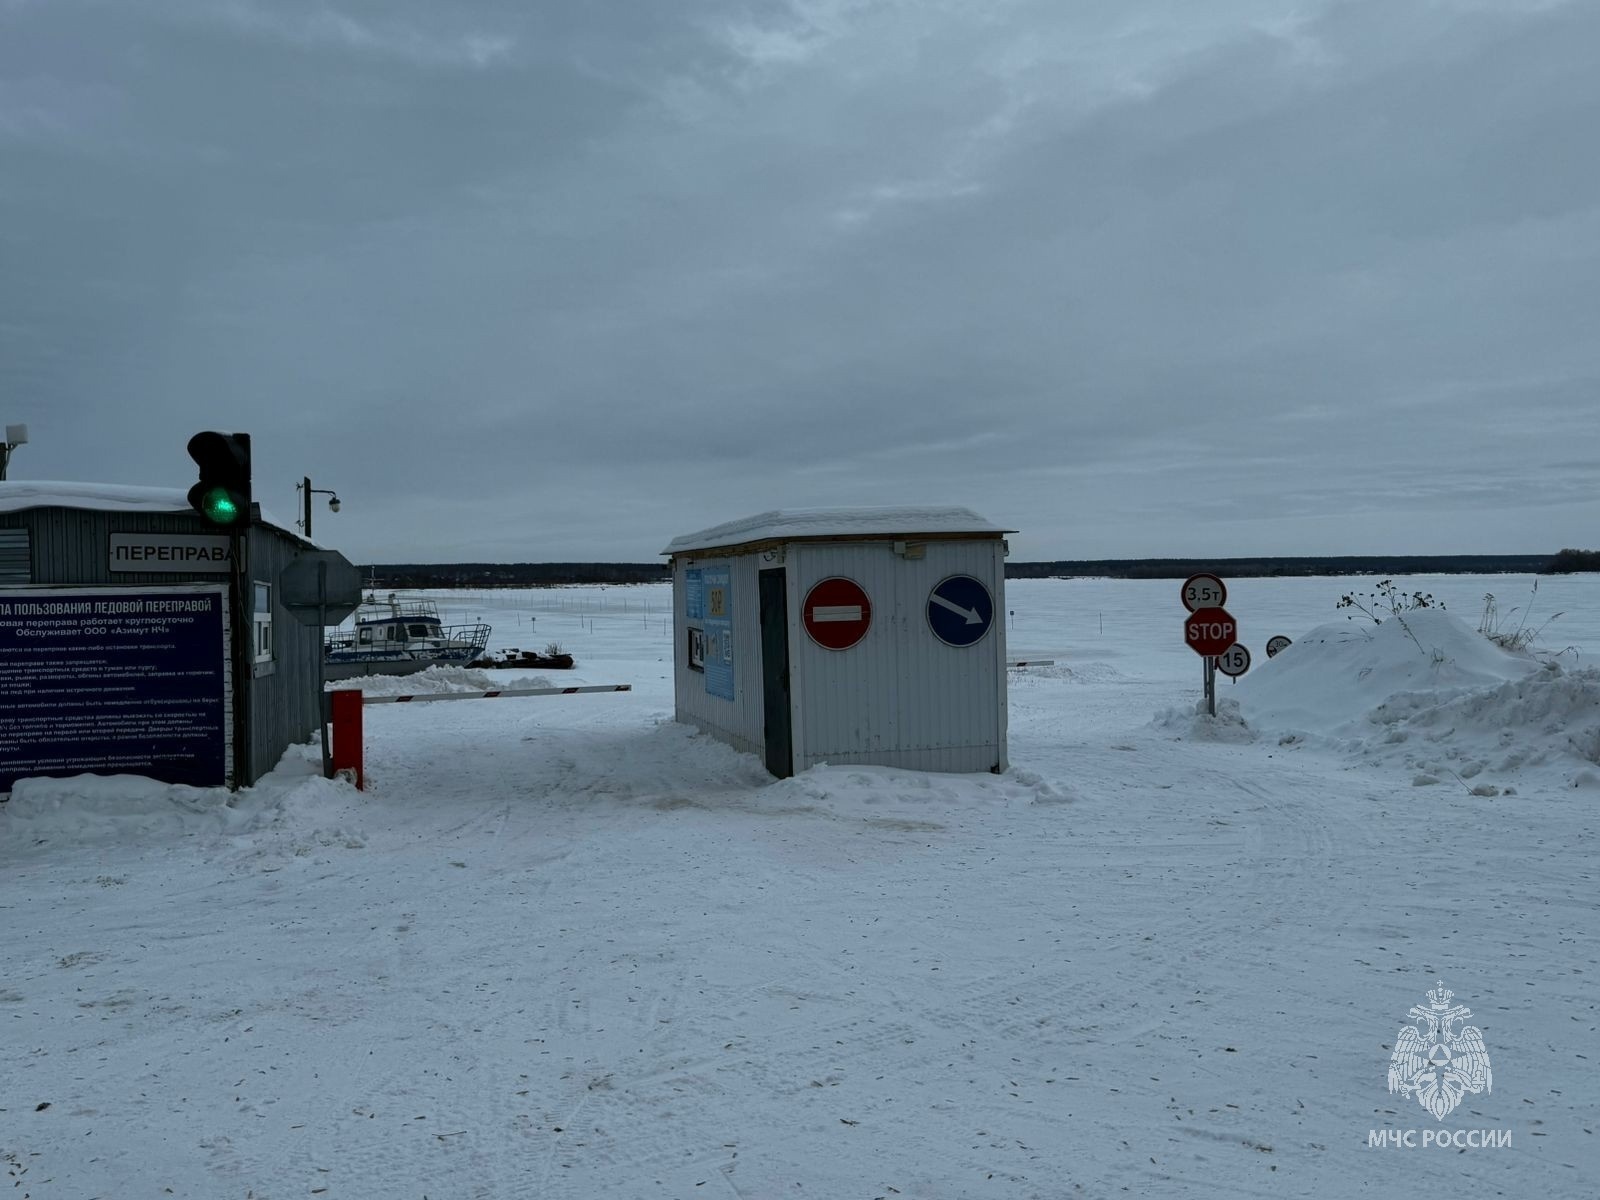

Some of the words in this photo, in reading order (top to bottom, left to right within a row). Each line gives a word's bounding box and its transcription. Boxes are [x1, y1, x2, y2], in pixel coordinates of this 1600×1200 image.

[14, 602, 92, 615] ПОЛЬЗОВАНИЯ
[94, 600, 143, 614] ЛЕДОВОЙ
[146, 598, 212, 612] ПЕРЕПРАВОЙ
[26, 618, 78, 628] переправа
[80, 618, 123, 626] работает
[125, 616, 194, 626] круглосуточно
[16, 628, 82, 638] Обслуживает
[84, 627, 107, 635] ООО
[1189, 623, 1233, 640] STOP
[1223, 652, 1243, 668] 15
